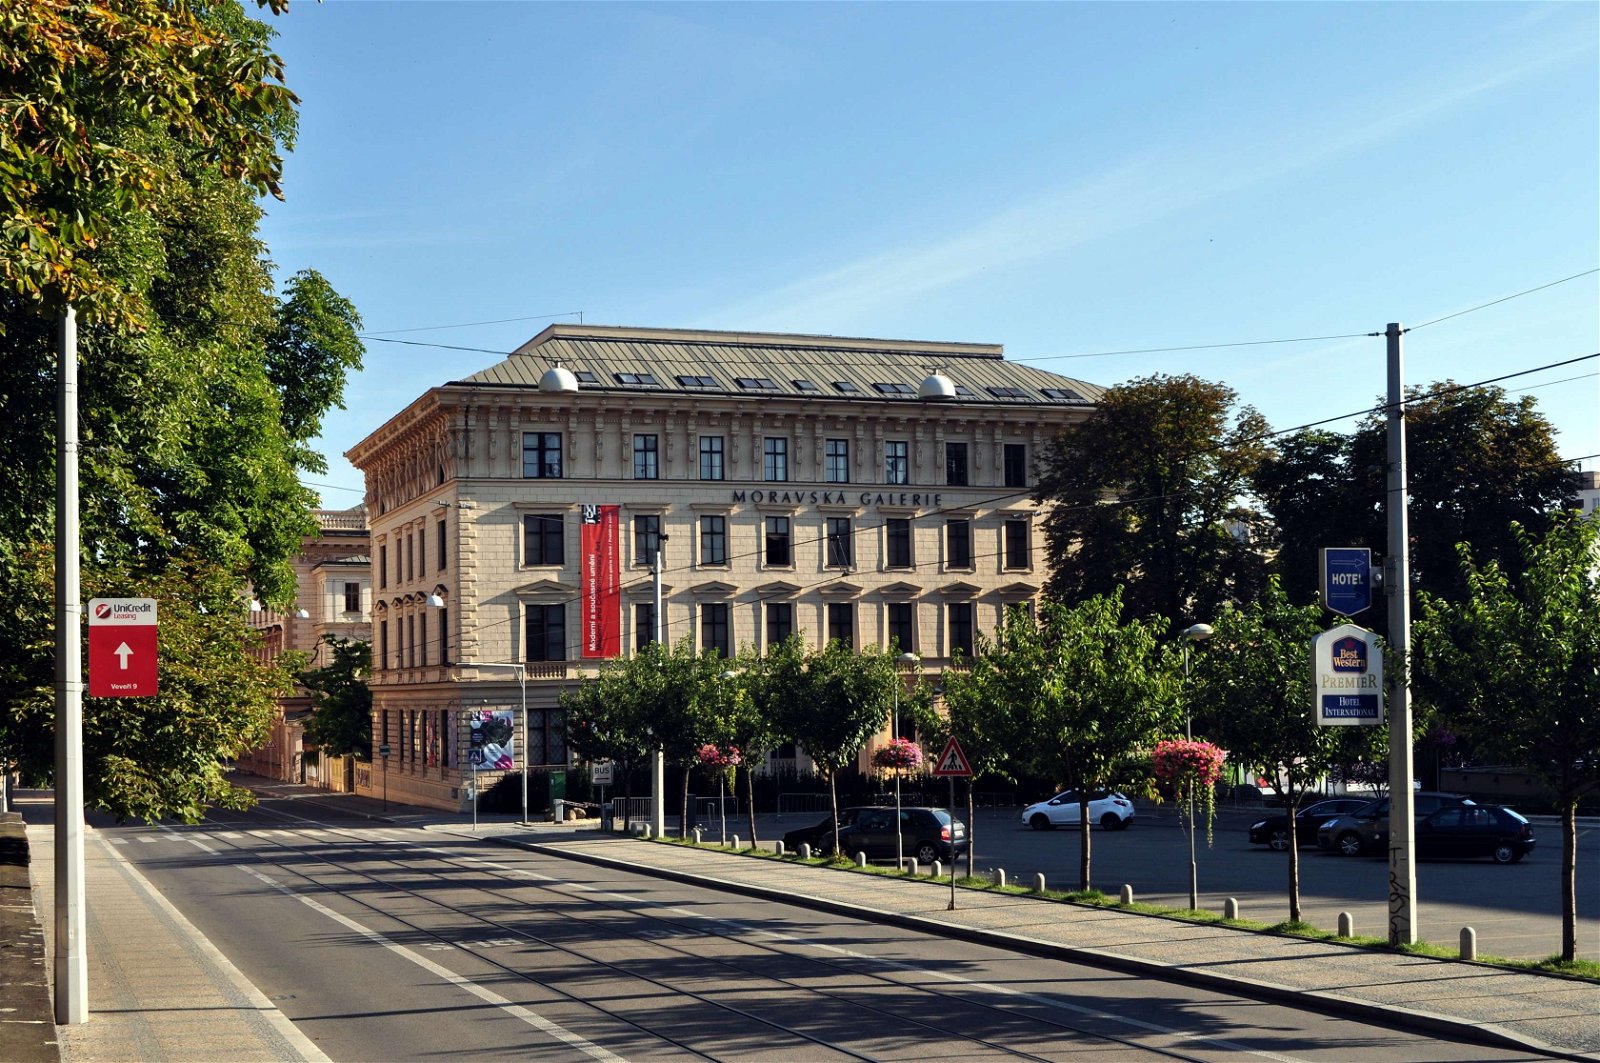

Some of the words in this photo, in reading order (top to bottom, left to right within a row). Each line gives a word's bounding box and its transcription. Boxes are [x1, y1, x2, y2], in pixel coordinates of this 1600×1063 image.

[733, 490, 846, 504] MORAVSKÁ
[860, 492, 942, 506] GALERIE
[588, 554, 596, 576] umění
[1332, 573, 1364, 585] HOTEL
[113, 604, 151, 613] UniCredit
[1340, 648, 1357, 659] Best
[1333, 657, 1366, 667] Western
[1321, 674, 1378, 689] PREMIER
[1339, 696, 1360, 706] HOTEL
[1325, 707, 1375, 717] INTERNATIONAL
